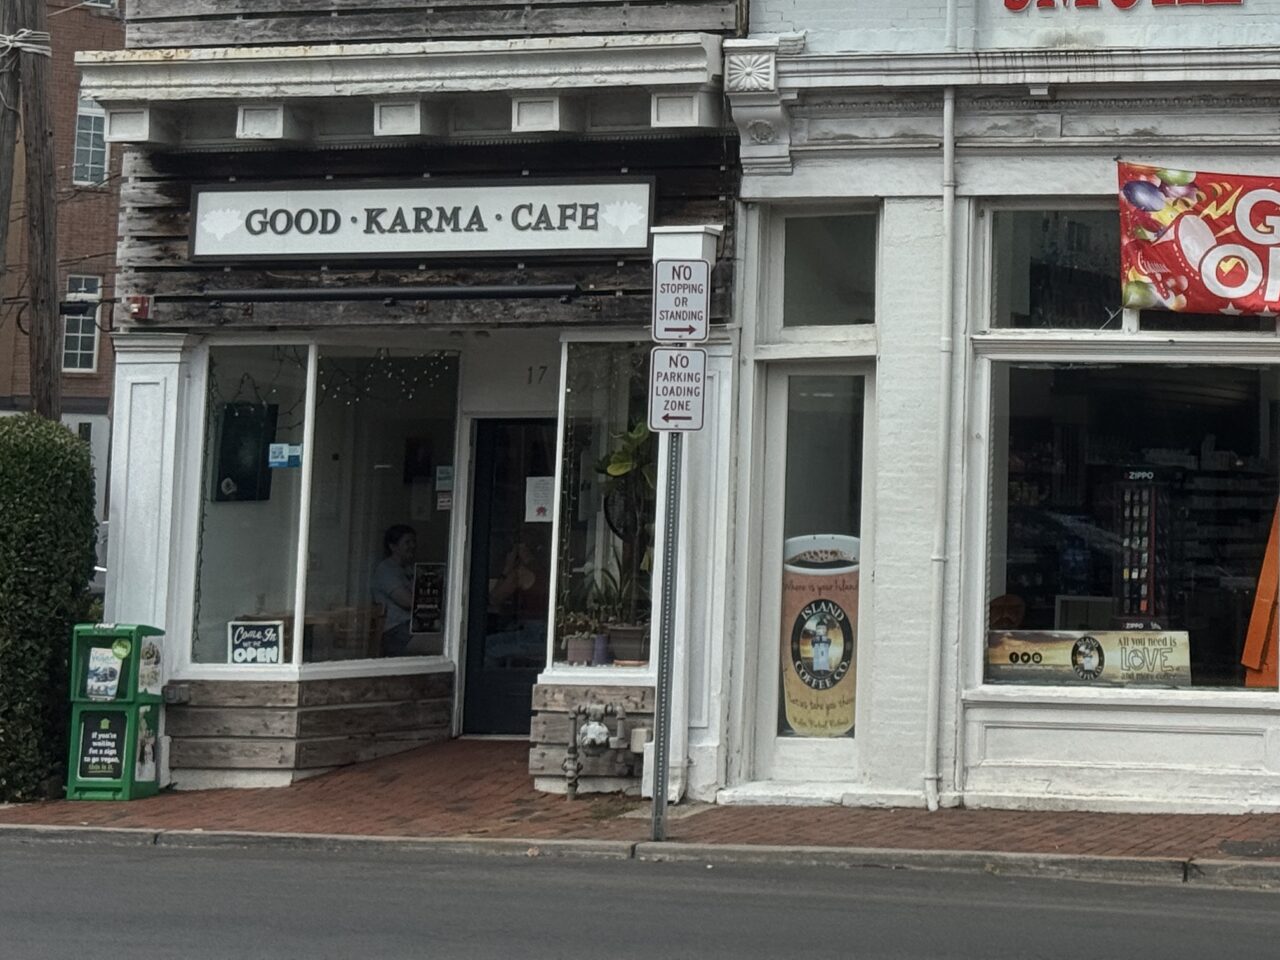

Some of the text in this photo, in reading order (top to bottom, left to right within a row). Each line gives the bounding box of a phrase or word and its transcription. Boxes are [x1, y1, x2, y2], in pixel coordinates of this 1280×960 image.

[245, 202, 600, 235] GOOD KARMA CAFE
[672, 265, 692, 281] NO
[660, 283, 704, 294] STOPPING
[674, 296, 688, 308] OR
[659, 310, 703, 321] STANDING
[669, 355, 689, 369] NO
[527, 366, 548, 385] 17
[656, 371, 701, 383] PARKING
[656, 385, 700, 397] LOADING
[663, 400, 691, 411] ZONE
[1129, 471, 1154, 480] ZIPPO
[801, 602, 845, 621] ISLAND
[234, 626, 262, 644] Come
[1131, 637, 1146, 649] you
[1148, 636, 1168, 647] need
[234, 646, 278, 662] OPEN
[795, 661, 834, 689] COFFEE
